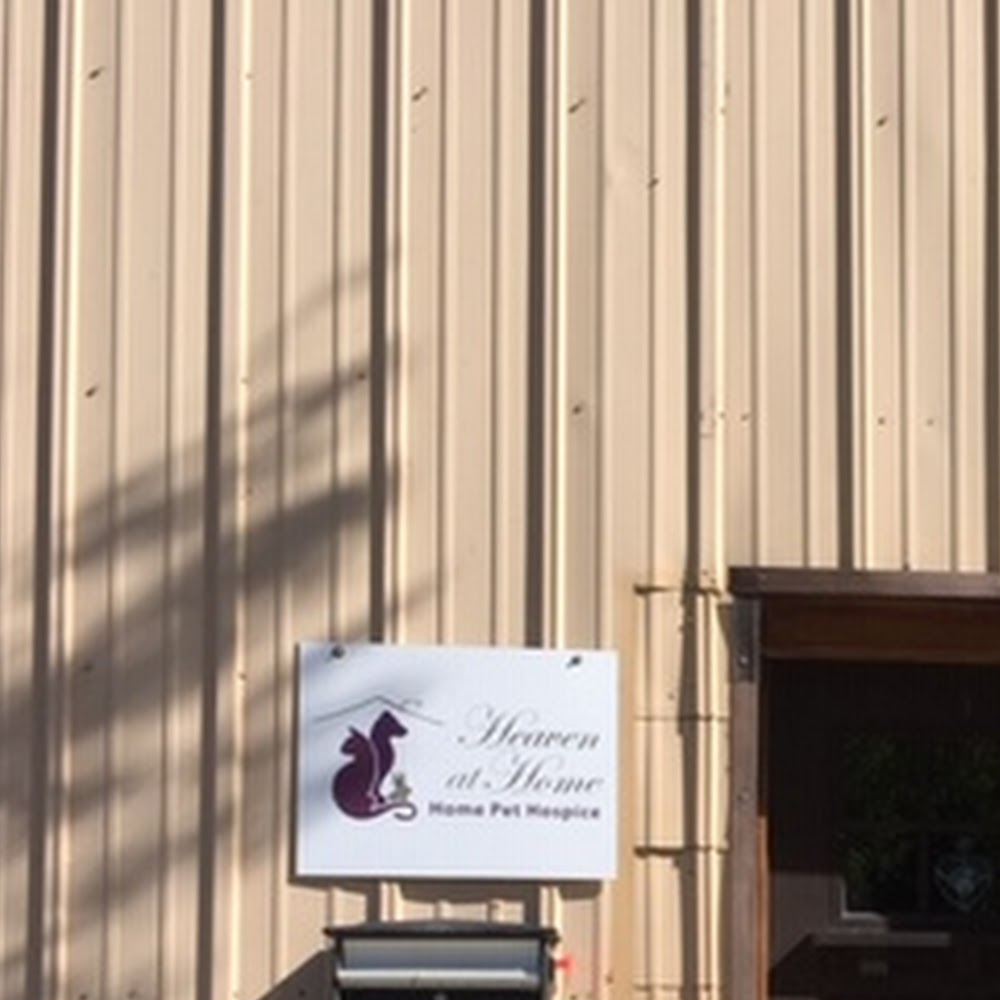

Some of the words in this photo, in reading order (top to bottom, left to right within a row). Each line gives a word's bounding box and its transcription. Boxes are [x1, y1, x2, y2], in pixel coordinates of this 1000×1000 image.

[456, 703, 601, 750] Heaven
[444, 767, 482, 790] at
[482, 752, 605, 795] Home
[428, 801, 484, 818] Home
[490, 801, 521, 819] Pet
[526, 802, 601, 822] Hospice
